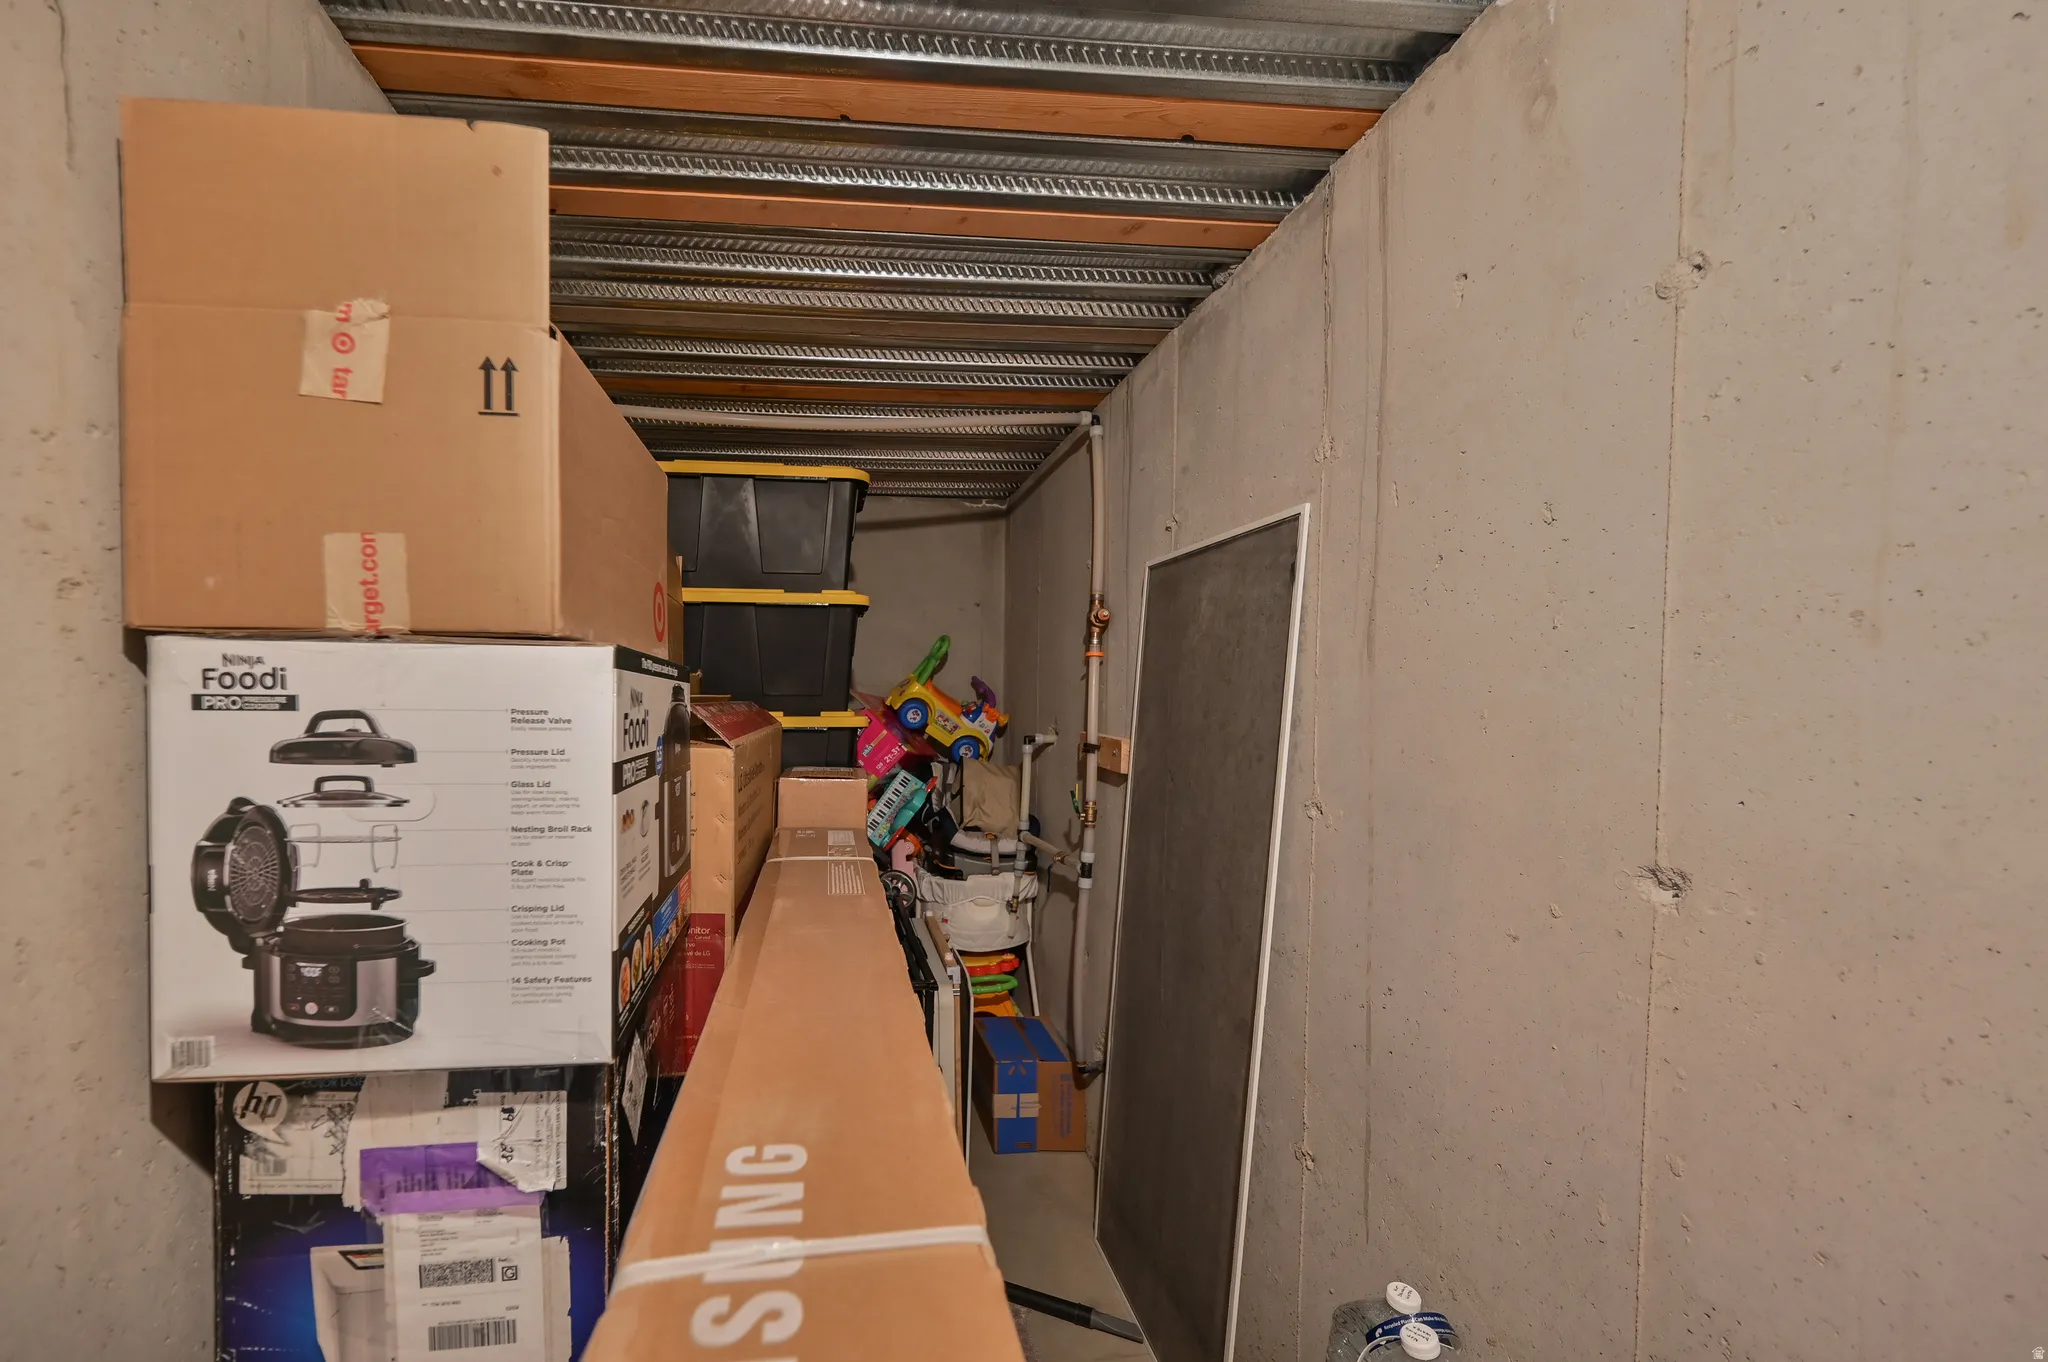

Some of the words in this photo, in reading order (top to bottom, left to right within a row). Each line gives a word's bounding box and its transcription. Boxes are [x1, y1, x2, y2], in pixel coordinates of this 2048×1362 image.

[222, 653, 265, 668] NINJA
[201, 667, 288, 690] Foodi
[201, 696, 241, 710] PRO
[510, 708, 549, 716] Pressure
[623, 709, 649, 751] Foodi
[510, 748, 549, 756] Pressure
[551, 748, 566, 756] Lid
[883, 745, 901, 763] 2T-3T
[622, 761, 636, 787] PRO
[510, 780, 535, 788] Glass
[536, 780, 551, 788] Lid
[510, 826, 546, 834] Nesting
[547, 825, 569, 833] Broil
[570, 825, 593, 833] Rack
[510, 905, 549, 913] Crisping
[550, 904, 565, 912] Lid
[510, 939, 549, 947] Cooking
[550, 938, 566, 946] Pot
[702, 949, 711, 957] LG
[522, 976, 552, 984] Safety
[239, 1082, 282, 1122] hp
[689, 1144, 808, 1362] SUNG
[504, 1267, 516, 1280] G
